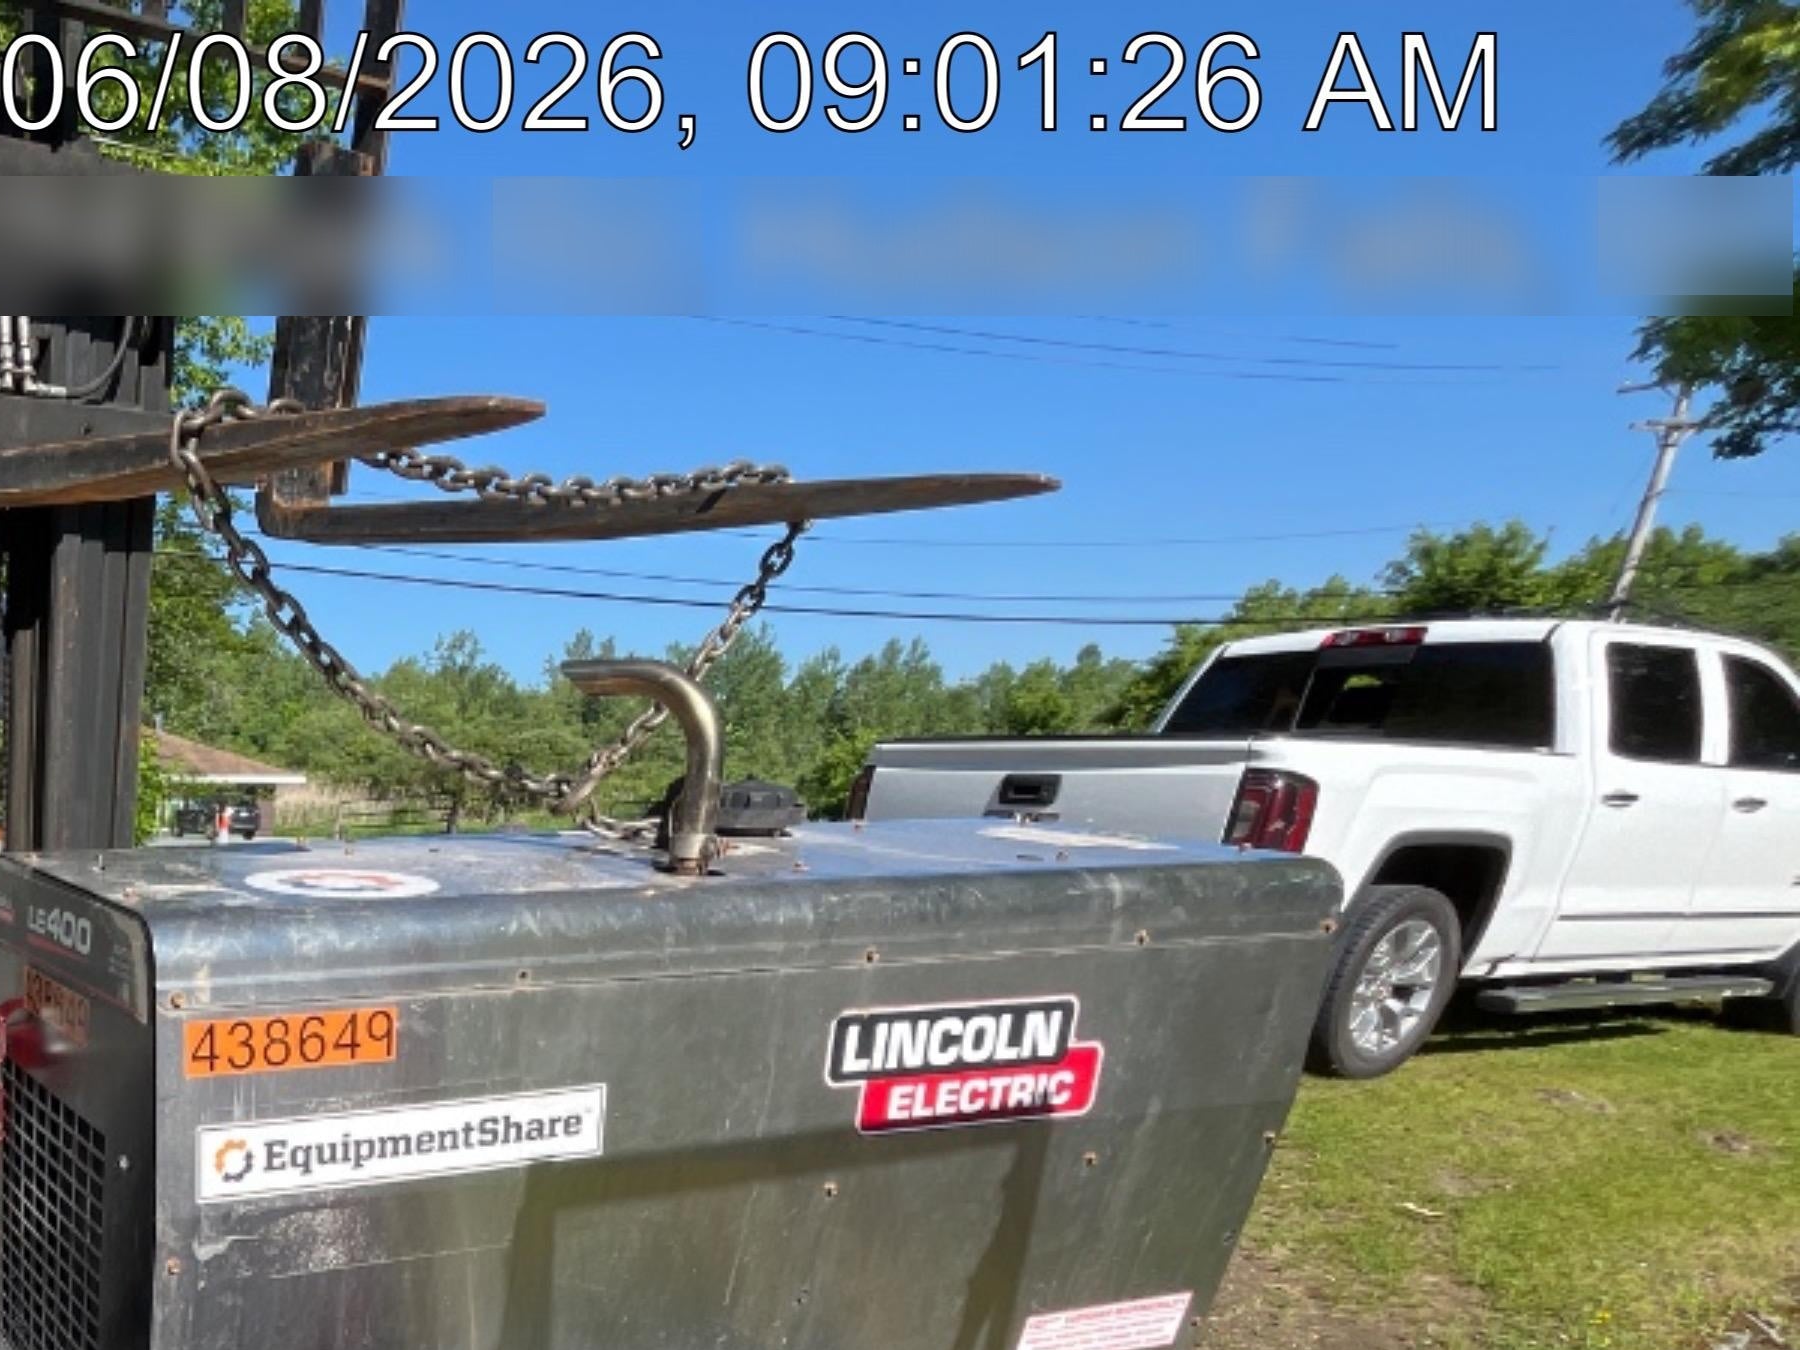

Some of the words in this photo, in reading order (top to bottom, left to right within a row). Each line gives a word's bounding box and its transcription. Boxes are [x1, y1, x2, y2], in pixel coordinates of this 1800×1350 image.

[191, 1010, 394, 1073] 438649
[841, 1009, 1064, 1074] LINCOLN
[886, 1069, 1075, 1121] ELECTRIC
[263, 1112, 584, 1175] EquipmentShare
